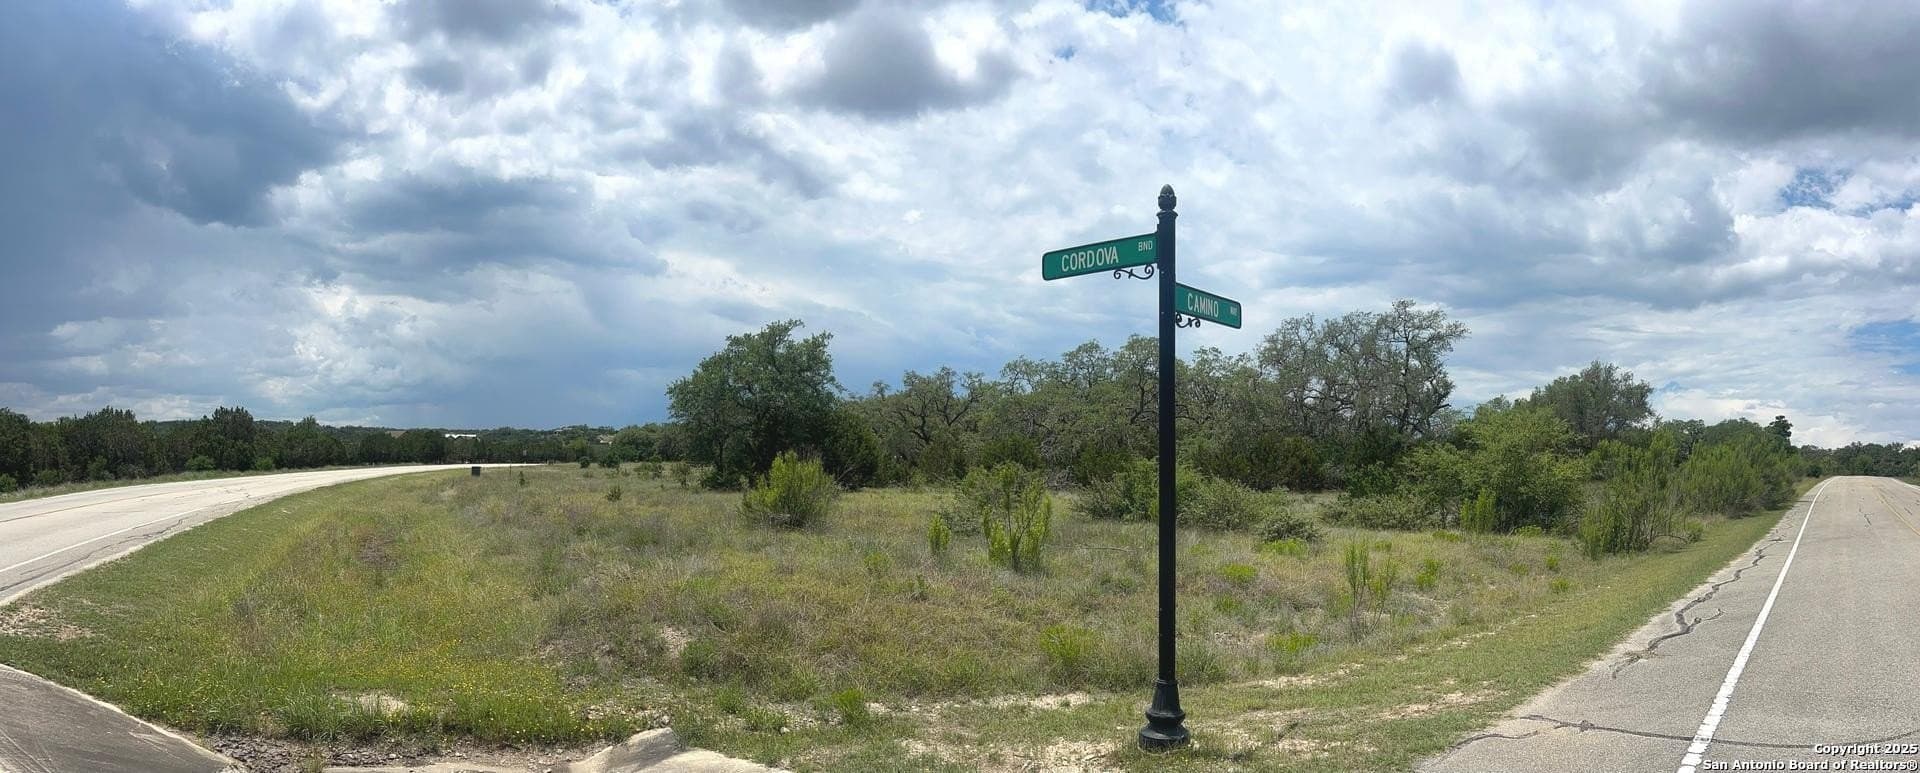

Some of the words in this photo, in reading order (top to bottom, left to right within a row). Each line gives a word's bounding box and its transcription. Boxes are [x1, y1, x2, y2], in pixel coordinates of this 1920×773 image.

[1061, 246, 1119, 272] CORDOVA
[1138, 241, 1153, 251] BND
[1187, 292, 1219, 318] CAMINO
